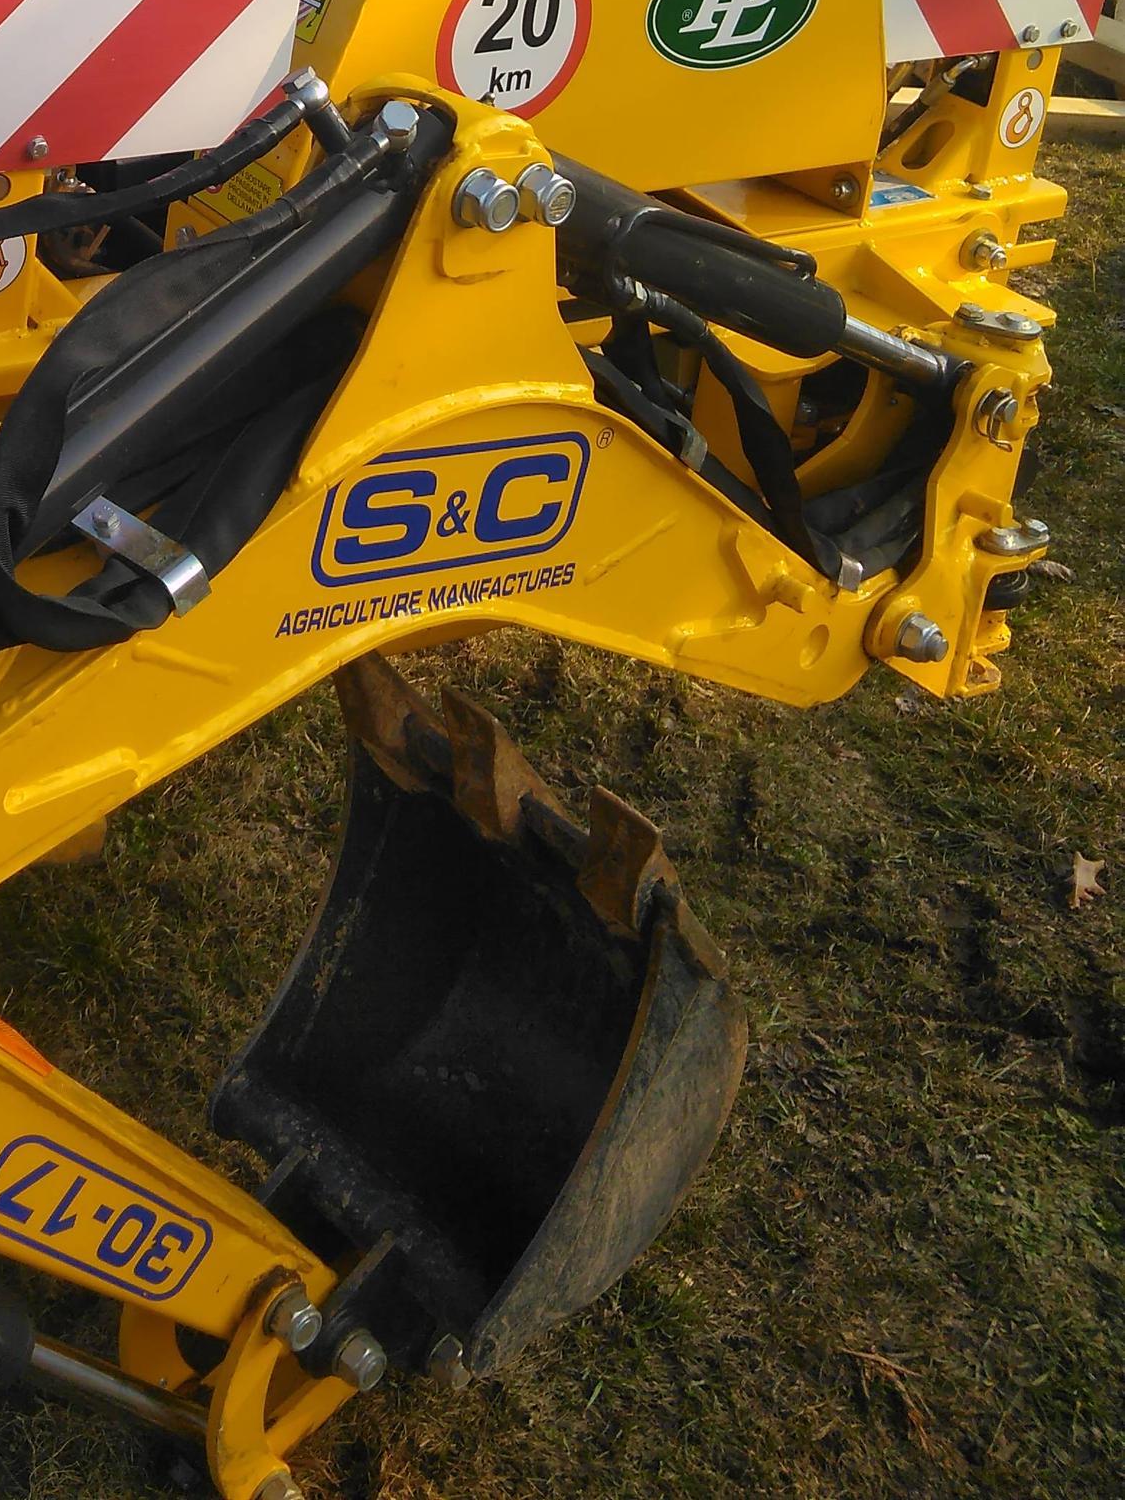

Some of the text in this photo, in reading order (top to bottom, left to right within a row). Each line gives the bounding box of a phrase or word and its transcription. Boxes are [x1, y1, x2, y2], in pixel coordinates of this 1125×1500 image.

[488, 66, 532, 93] km
[333, 453, 570, 565] S&C
[275, 562, 577, 638] AGRICULTURE MANIFACTURES
